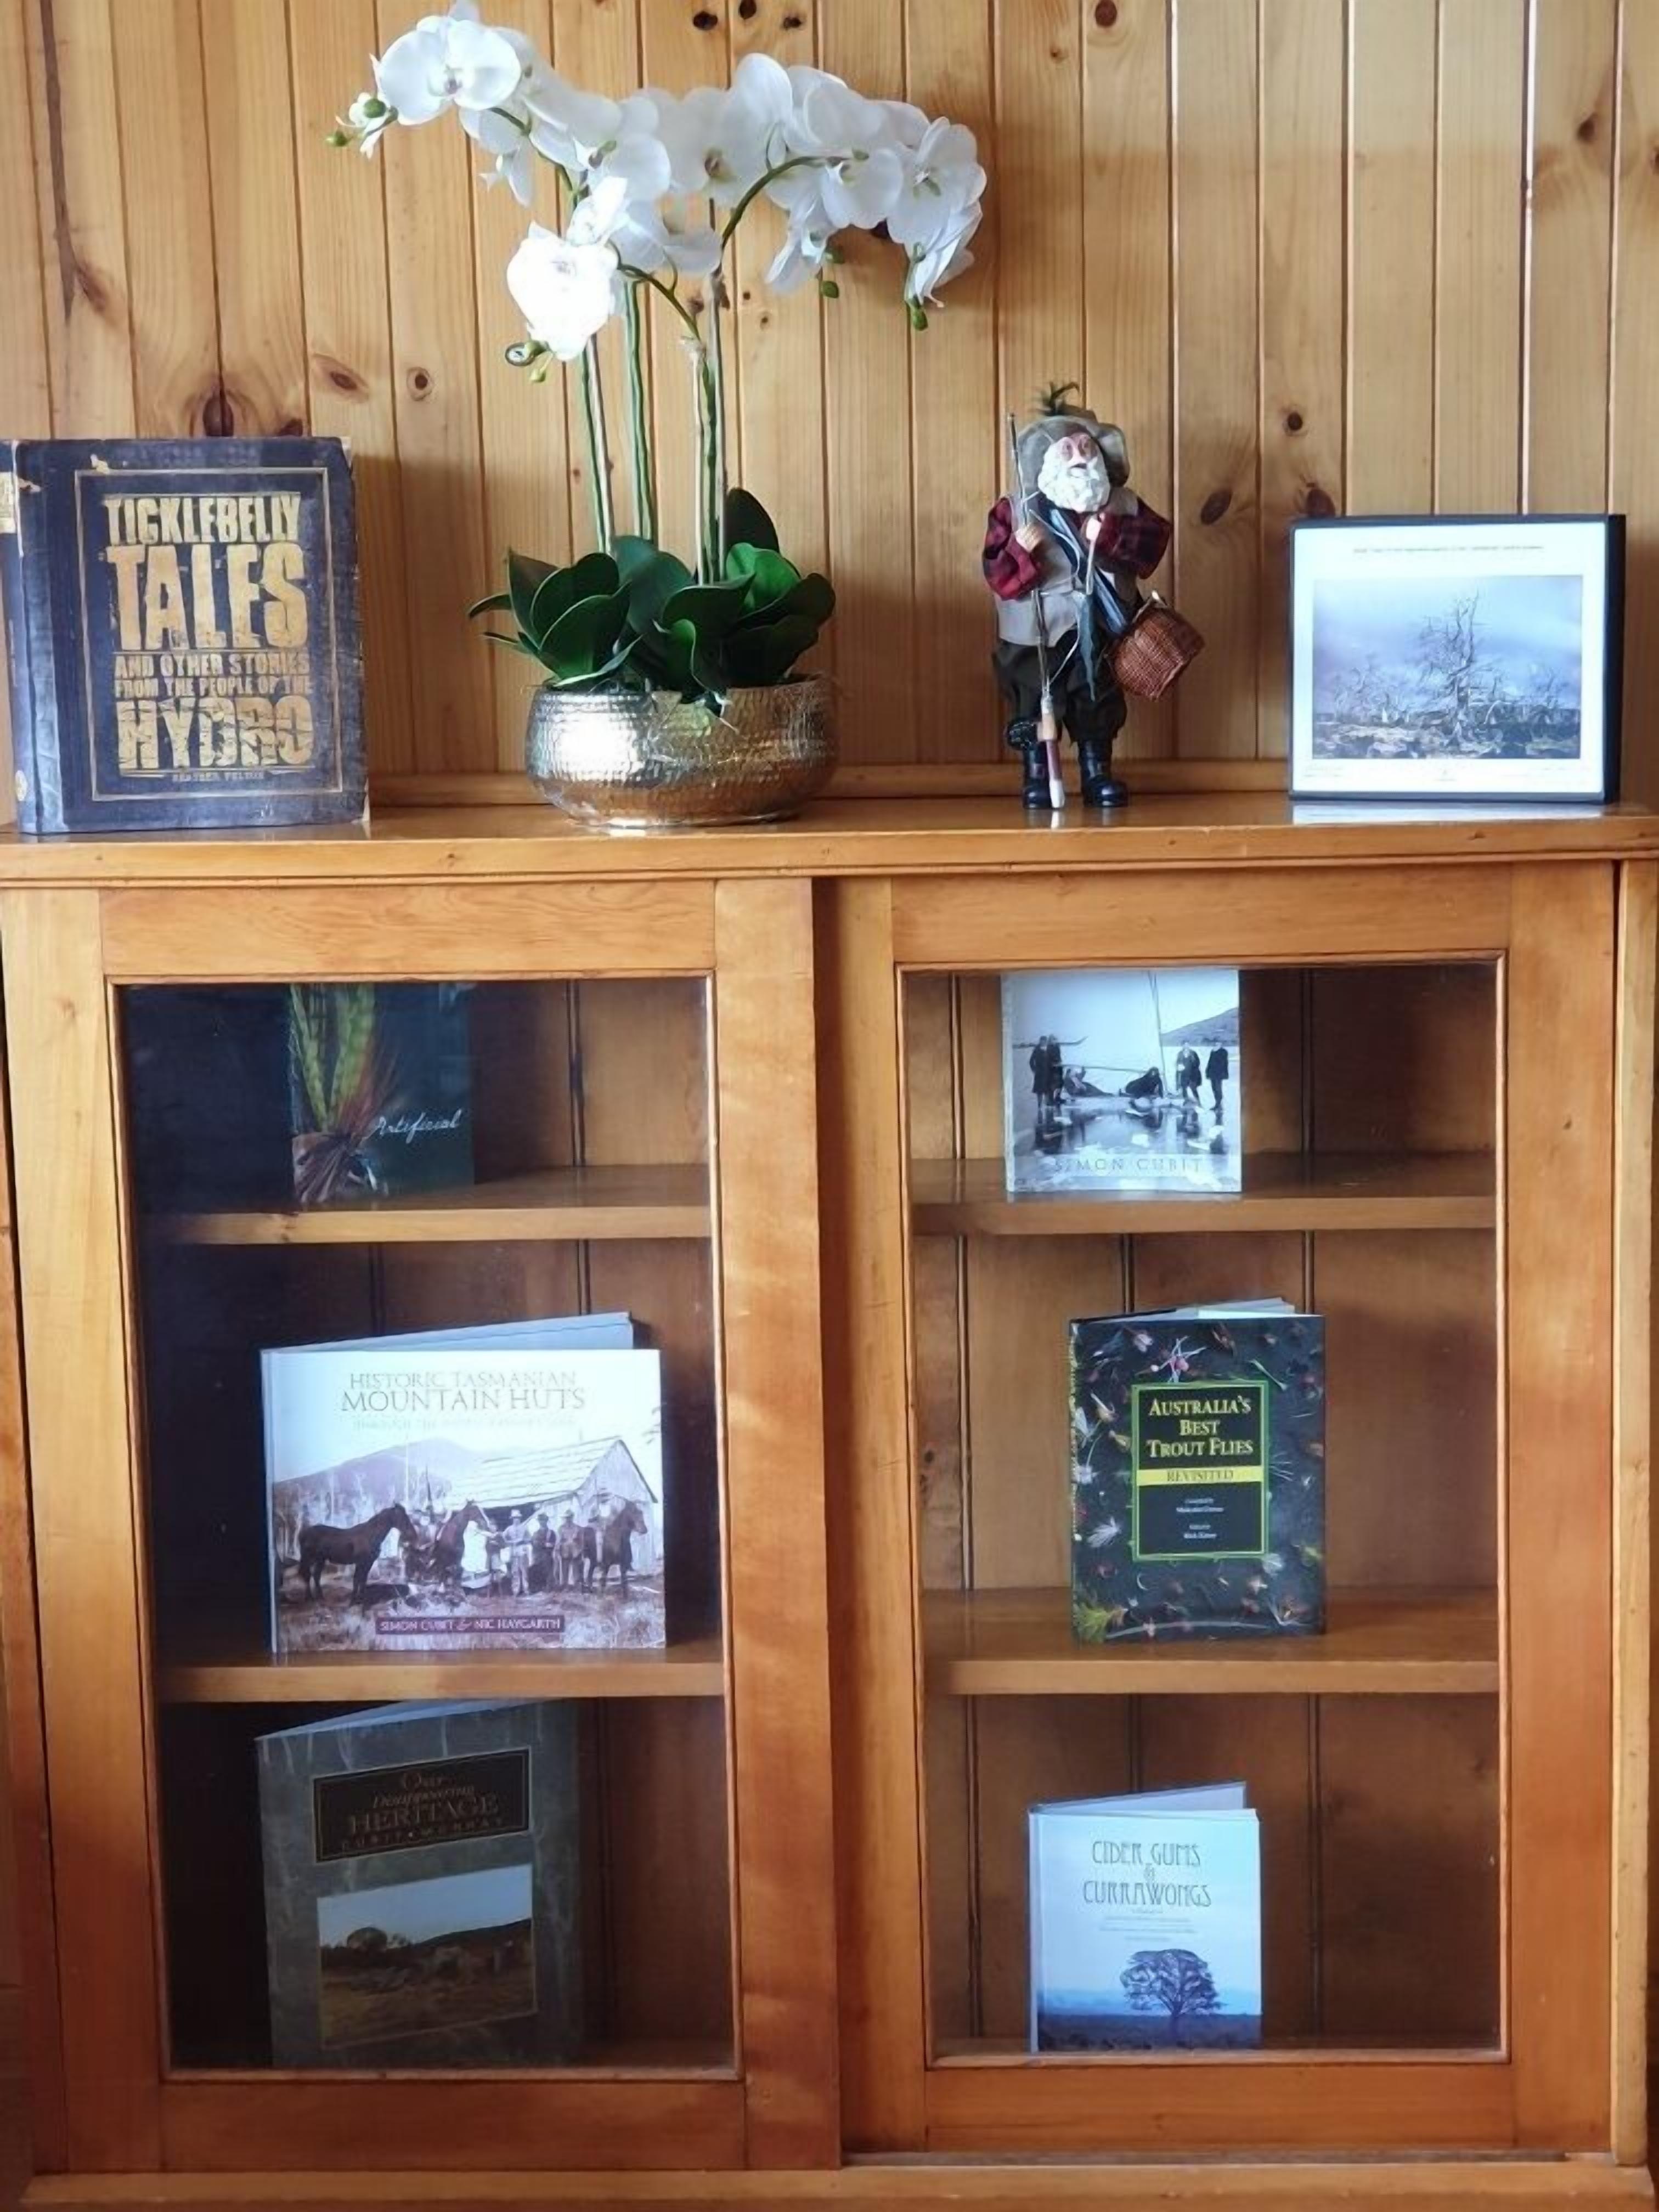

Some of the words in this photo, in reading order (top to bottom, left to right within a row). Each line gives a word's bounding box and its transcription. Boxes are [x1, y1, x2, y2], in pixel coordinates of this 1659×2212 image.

[104, 495, 301, 544] TICKLEBELLY
[106, 541, 308, 650] TALES
[115, 656, 154, 679] AND
[160, 654, 223, 676] OTHER
[228, 653, 310, 675] STORIES
[115, 678, 159, 697] FROM
[164, 677, 196, 697] THE
[199, 676, 253, 696] PEOPLE
[257, 676, 281, 695] OF
[116, 695, 314, 769] HYDRO
[1055, 1158, 1124, 1172] SIMON
[1137, 1158, 1203, 1172] CUBIT
[350, 1373, 445, 1389] HISTORIC
[450, 1370, 577, 1388] TASMANIAN
[341, 1389, 499, 1411] MOUNTAIN
[510, 1387, 585, 1410] HUTS
[1148, 1395, 1251, 1416] AUSTRALIA'S
[1180, 1419, 1221, 1436] BEST
[1146, 1439, 1205, 1458] TROUT
[1209, 1437, 1254, 1457] FLIES
[379, 1621, 417, 1631] SIMON
[351, 1793, 499, 1835] HERITAGE
[1092, 1841, 1143, 1864] CIDER
[1150, 1843, 1201, 1866] GUMS
[1084, 1880, 1212, 1907] CURRAWONGS
